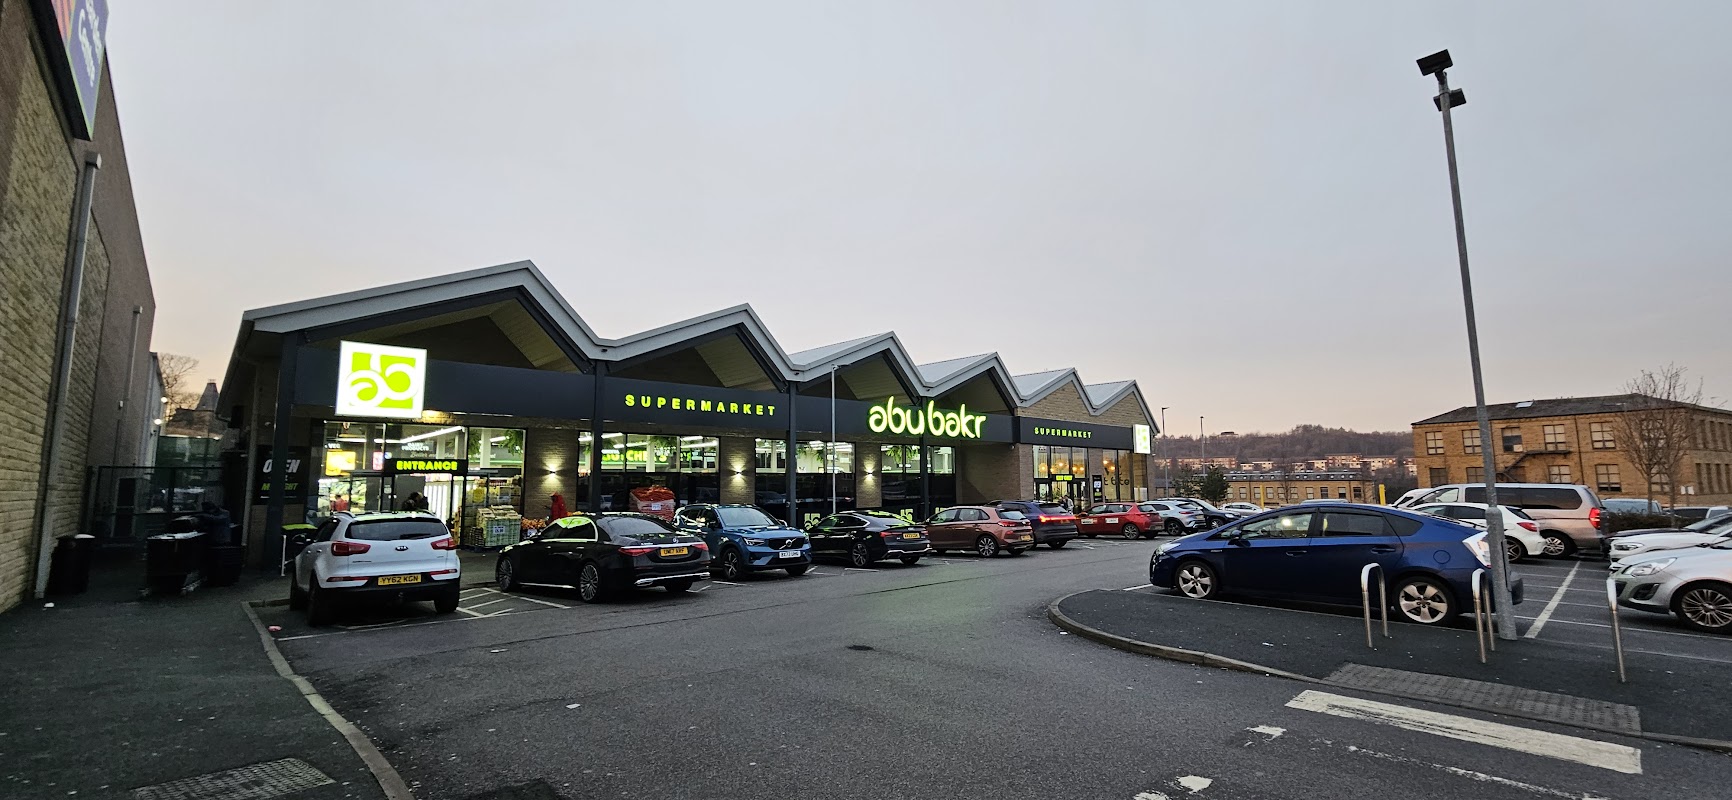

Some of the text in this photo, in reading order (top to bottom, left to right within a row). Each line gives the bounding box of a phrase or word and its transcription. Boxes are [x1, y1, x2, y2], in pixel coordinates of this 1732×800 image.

[625, 394, 775, 416] SUPERMARKET
[869, 396, 987, 439] abu bakr
[1034, 427, 1092, 439] SUPERMARKET
[262, 459, 301, 473] OEN
[396, 461, 458, 470] ENTRANCE
[381, 576, 402, 584] YY62
